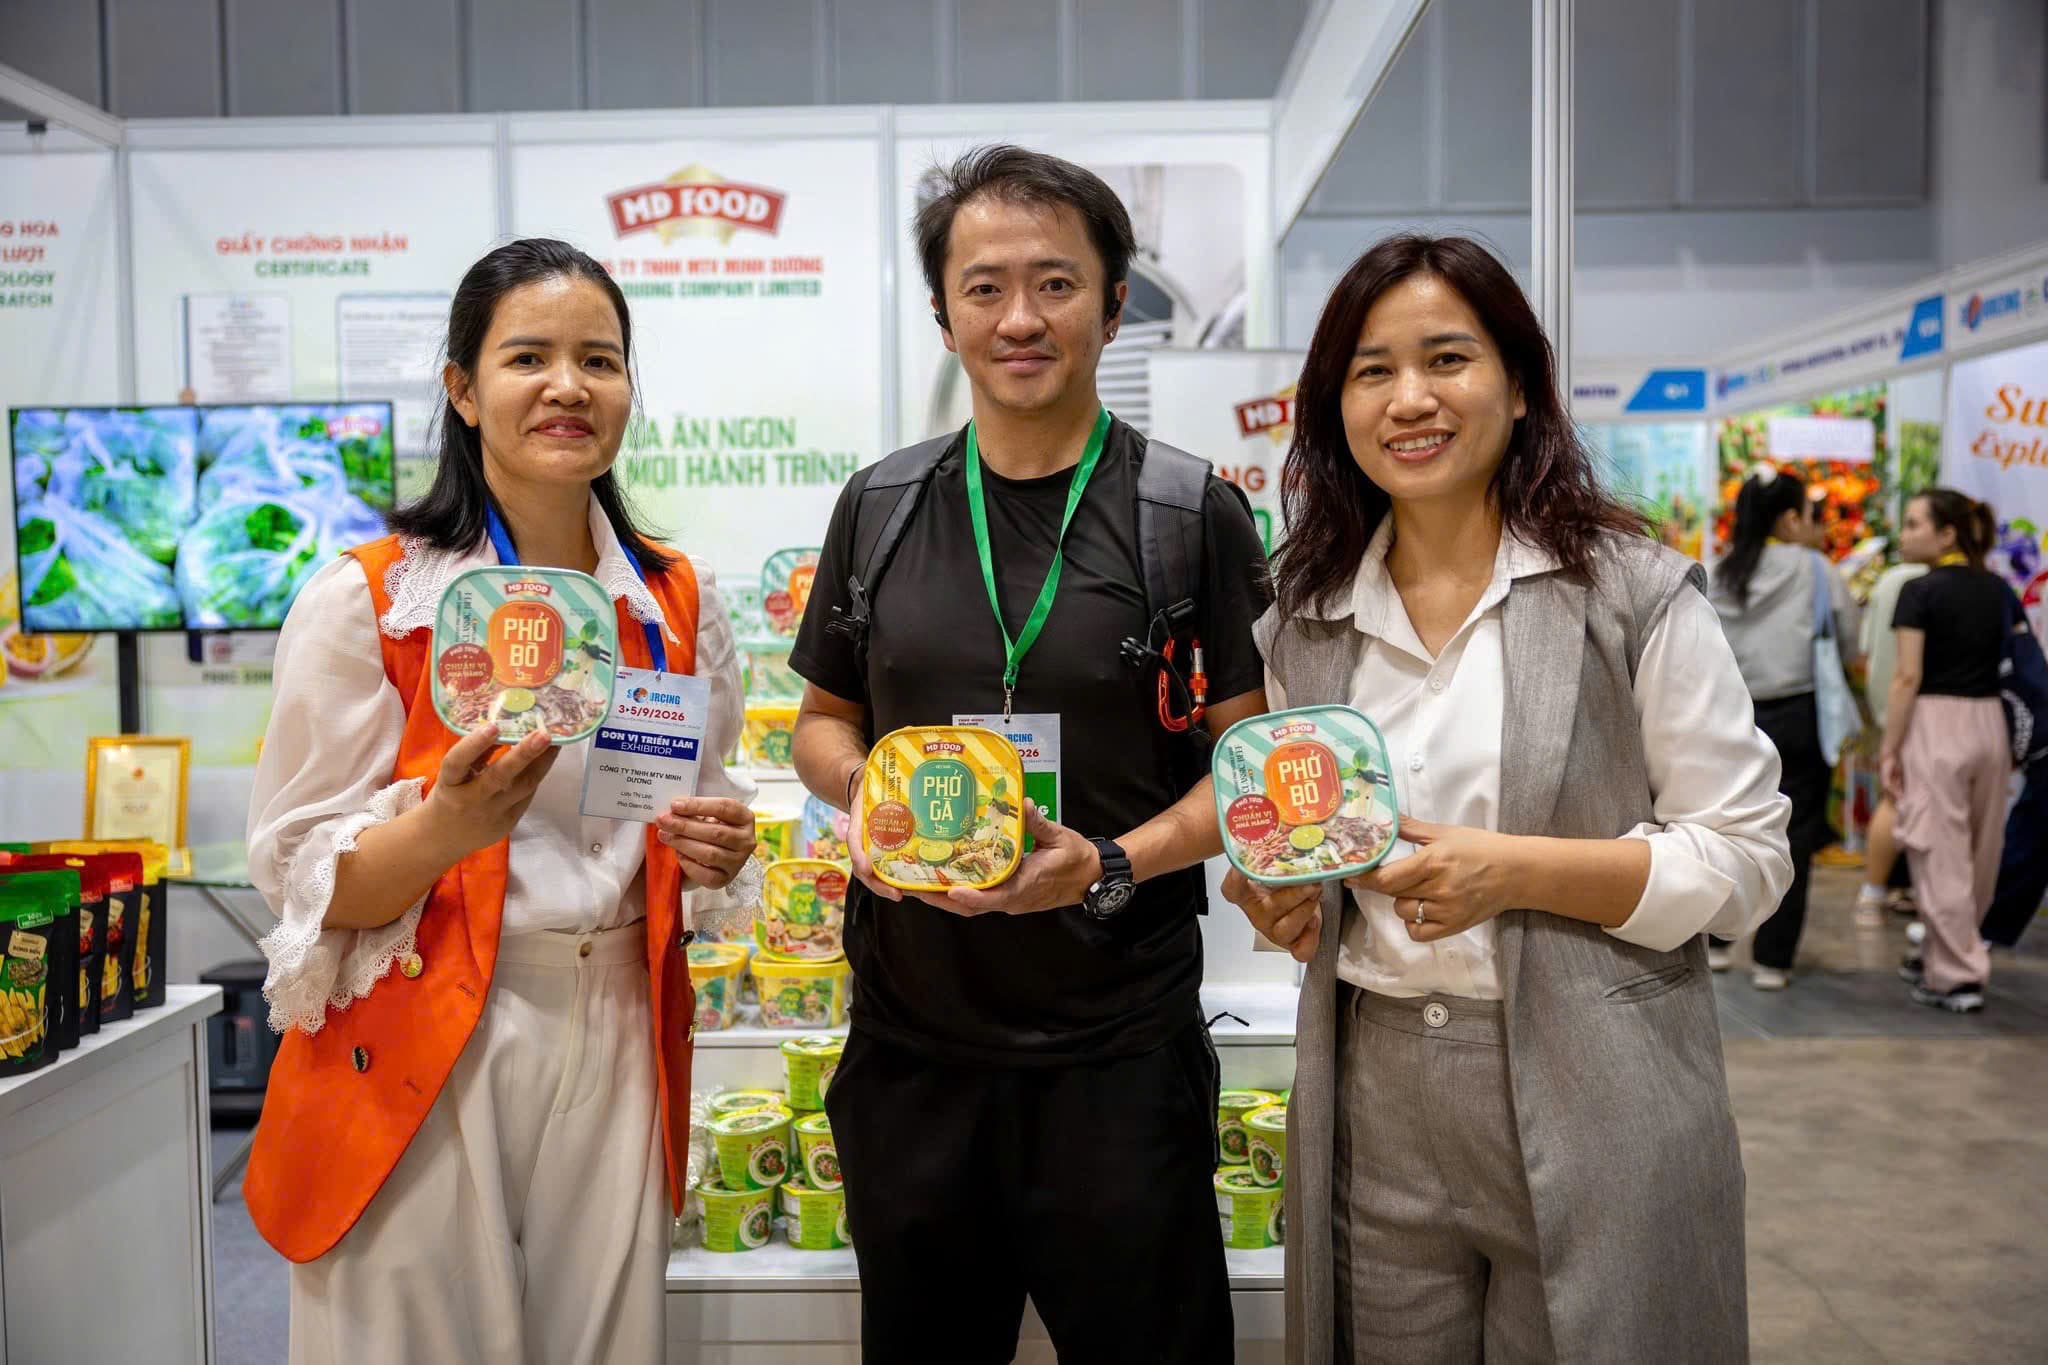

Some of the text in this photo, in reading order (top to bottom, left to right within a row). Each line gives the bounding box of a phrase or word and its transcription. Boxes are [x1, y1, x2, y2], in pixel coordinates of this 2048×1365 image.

[622, 188, 770, 224] MD FOOD
[255, 259, 370, 277] CERTIFICATE
[671, 411, 709, 448] ĂN
[718, 417, 796, 448] NGON
[687, 448, 765, 485] HÀNH
[523, 583, 549, 593] FOOD
[504, 612, 549, 641] PHỞ
[509, 642, 540, 667] BÒ
[1289, 724, 1313, 734] FOOD
[621, 743, 672, 756] EXHIBITOR
[926, 742, 961, 752] MD FOOD
[600, 764, 619, 773] CÔNG
[631, 769, 649, 777] TNHH
[665, 773, 682, 781] MINH
[1278, 750, 1322, 784] PHỞ
[923, 770, 963, 796] PHỞ
[1290, 780, 1319, 807] BÒ
[929, 797, 954, 821] GÀ
